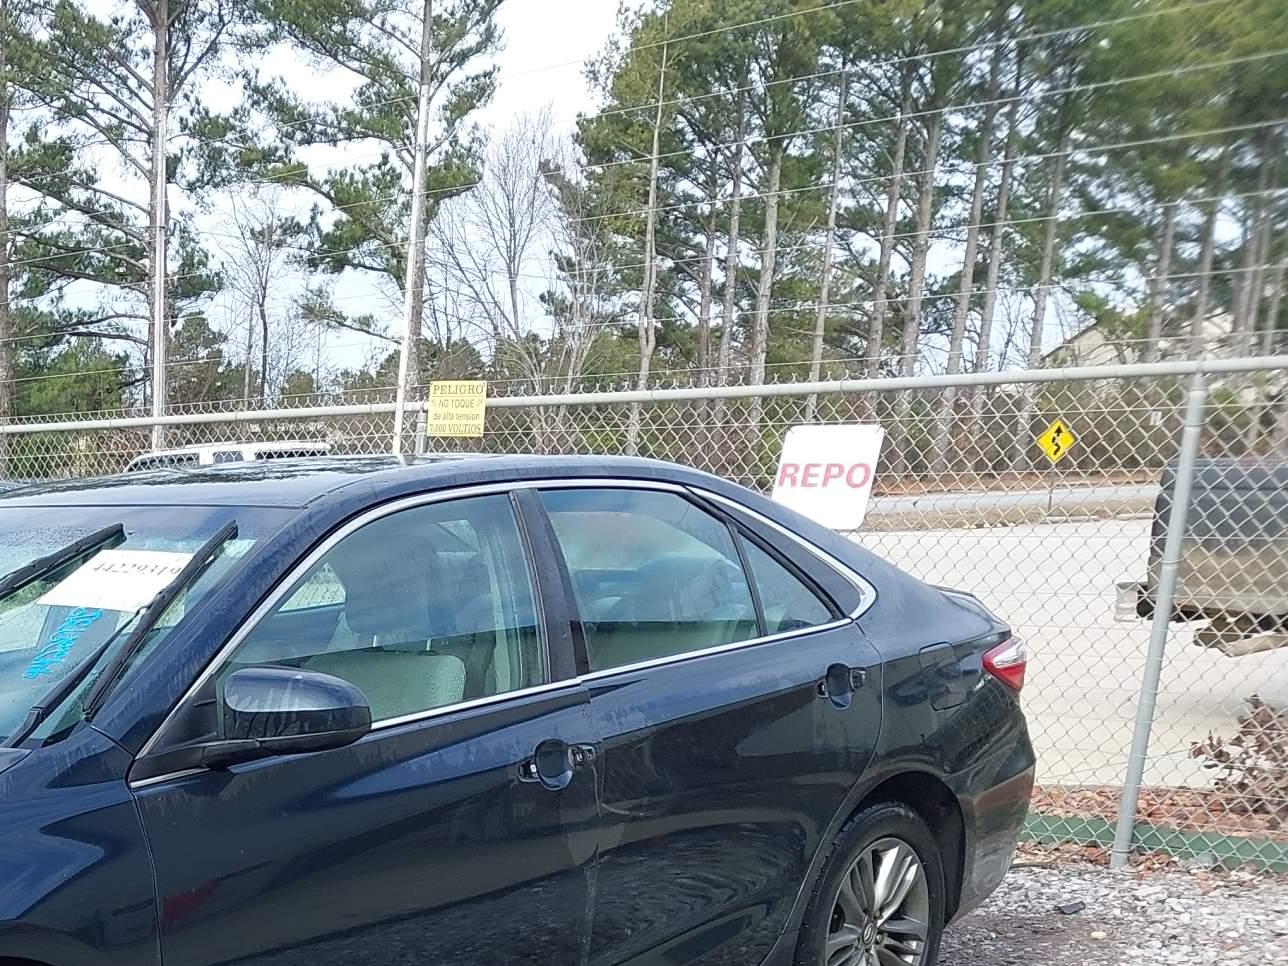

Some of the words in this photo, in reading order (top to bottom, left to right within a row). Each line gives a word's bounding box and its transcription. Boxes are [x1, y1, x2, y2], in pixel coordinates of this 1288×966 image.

[432, 384, 484, 395] PELIGRO
[439, 399, 449, 408] NO
[451, 399, 476, 408] TOQUE
[448, 423, 481, 434] VOLTIOS
[777, 463, 871, 488] REPO
